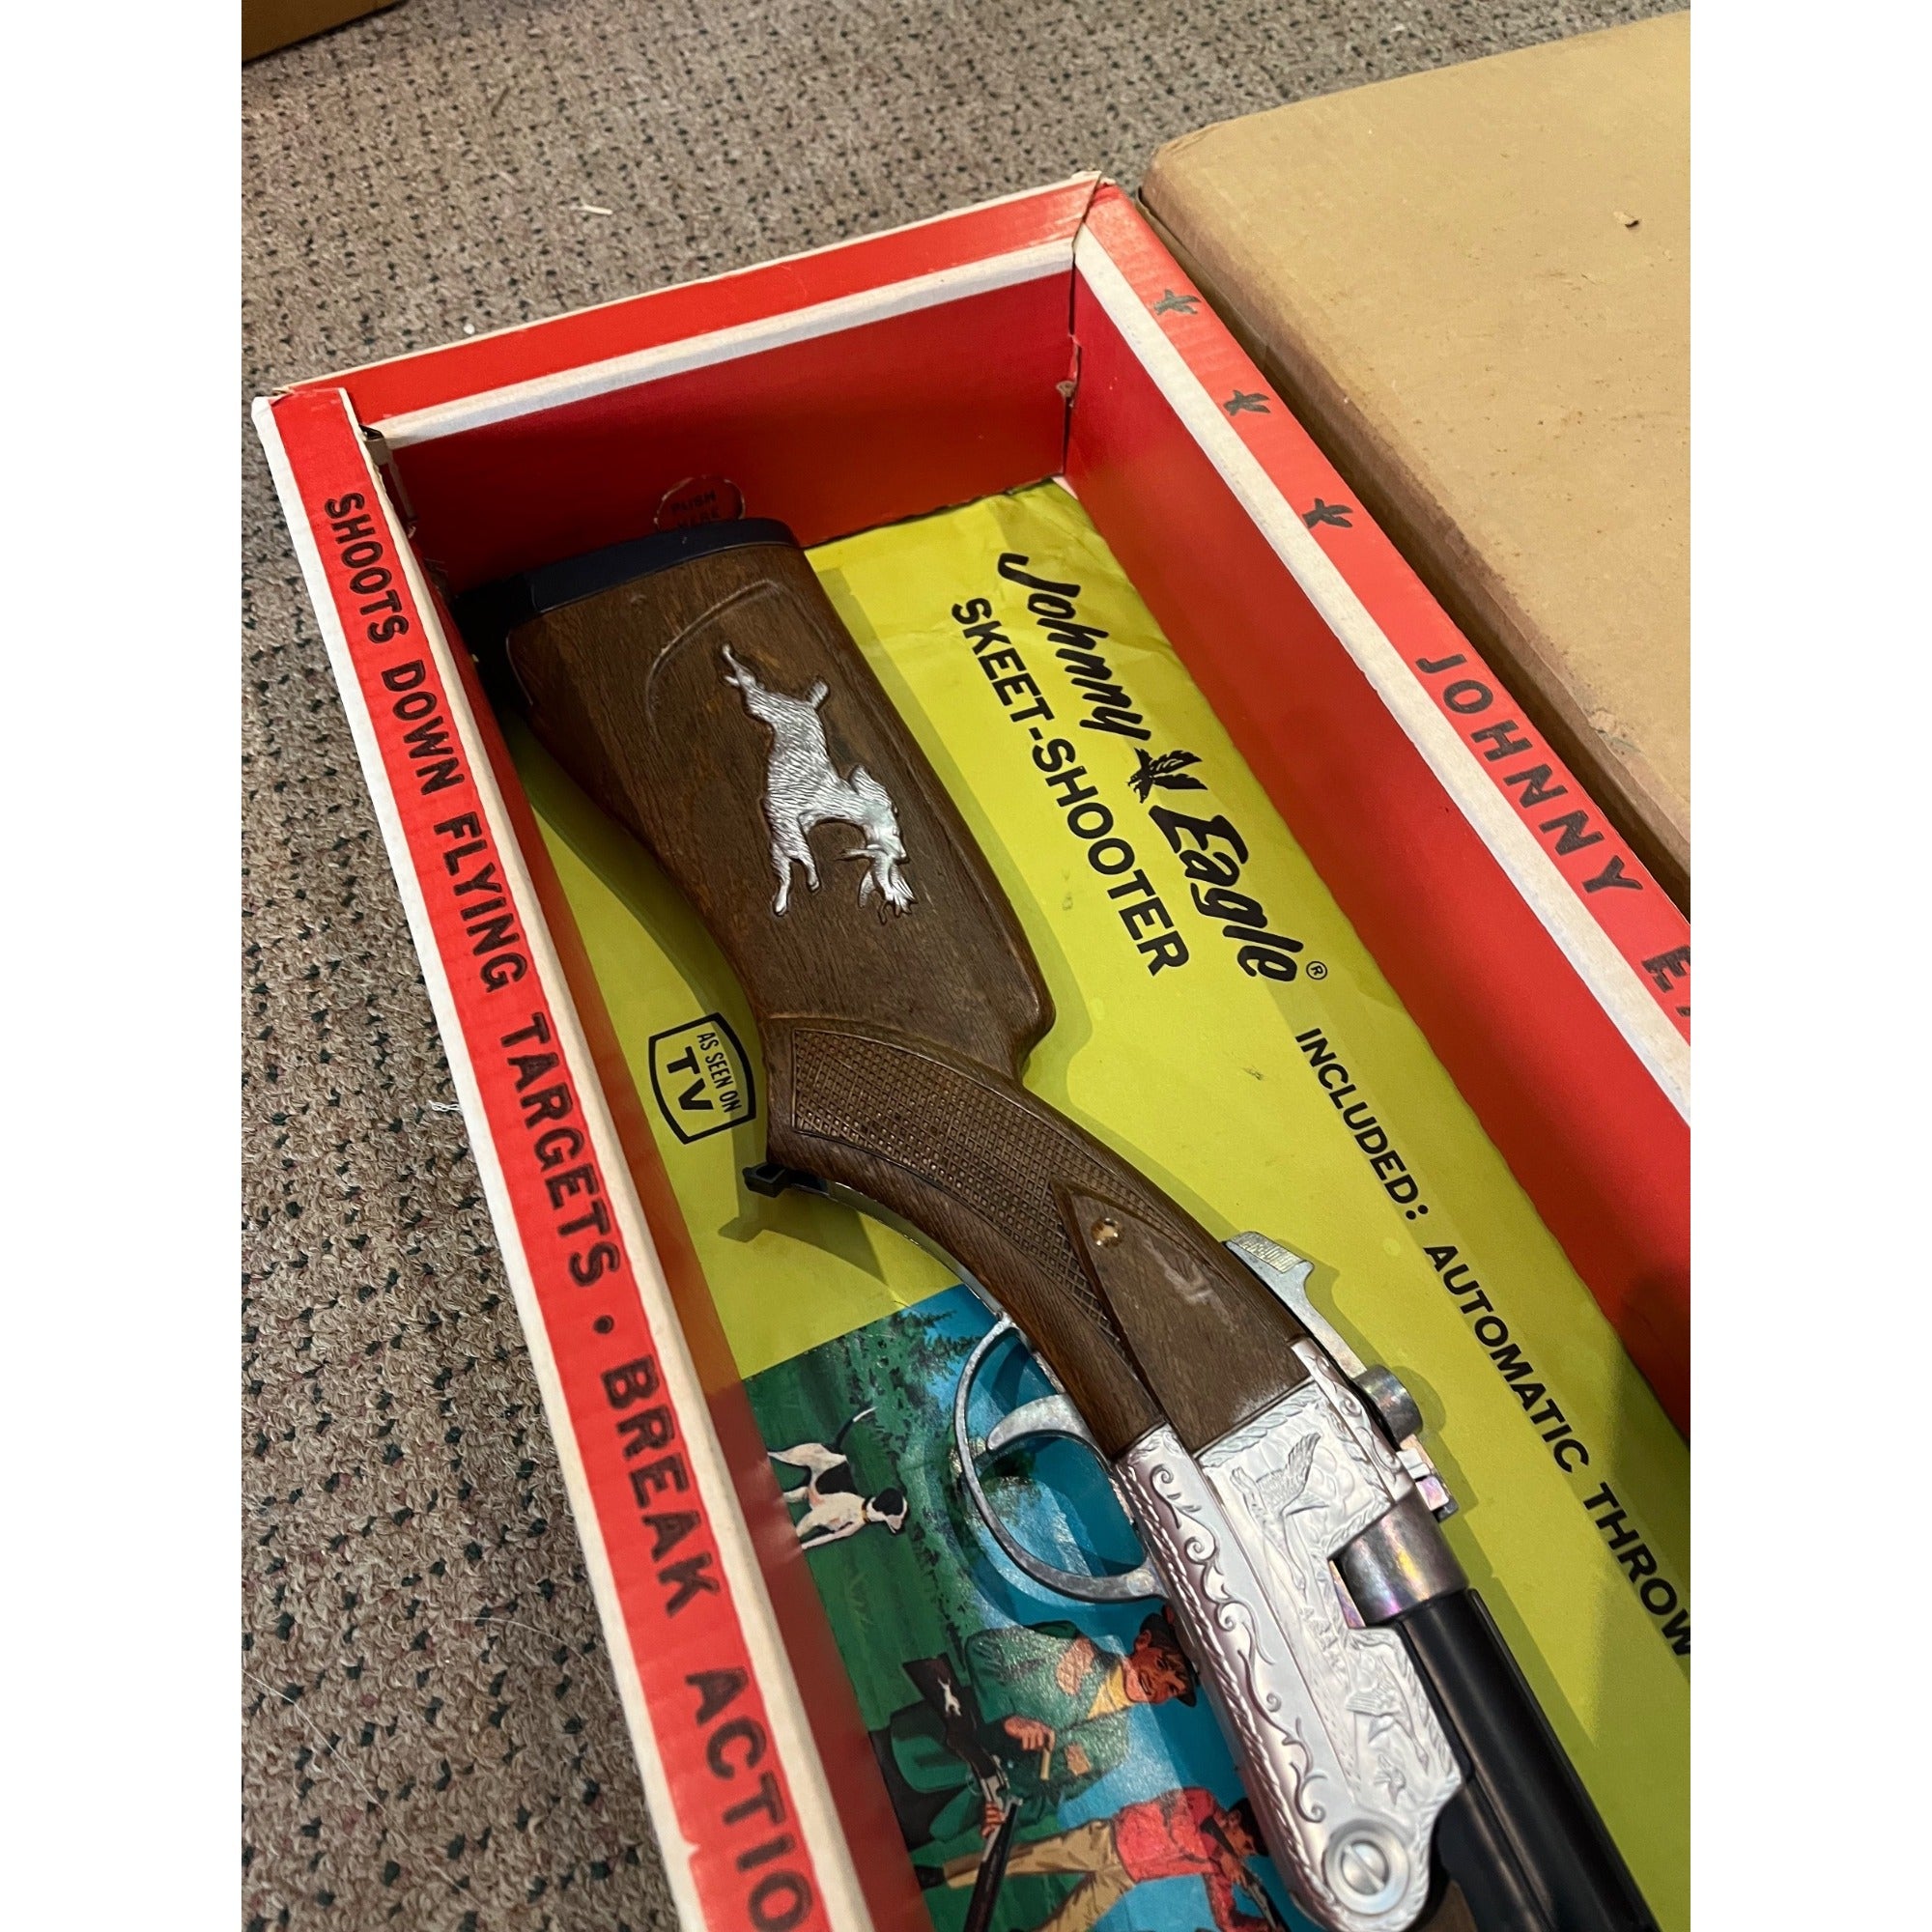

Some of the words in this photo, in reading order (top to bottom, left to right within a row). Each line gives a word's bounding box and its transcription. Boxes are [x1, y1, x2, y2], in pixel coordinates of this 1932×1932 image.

[997, 553, 1151, 742] Johnny
[951, 597, 1190, 977] SKEET-SHOOTER
[1415, 653, 1644, 894] JOHNNY
[325, 492, 410, 644] SHOOTS
[381, 659, 466, 796] DOWN
[434, 810, 528, 993] FLYING
[500, 1011, 620, 1288] TARGETS
[601, 1356, 720, 1617] BREAK
[667, 1045, 714, 1111] TV
[696, 1032, 720, 1051] AS
[705, 1052, 734, 1090] SEEN
[719, 1090, 743, 1113] ON
[1295, 1027, 1429, 1221] INCLUDED:
[1423, 1244, 1590, 1473] AUTOMATIC
